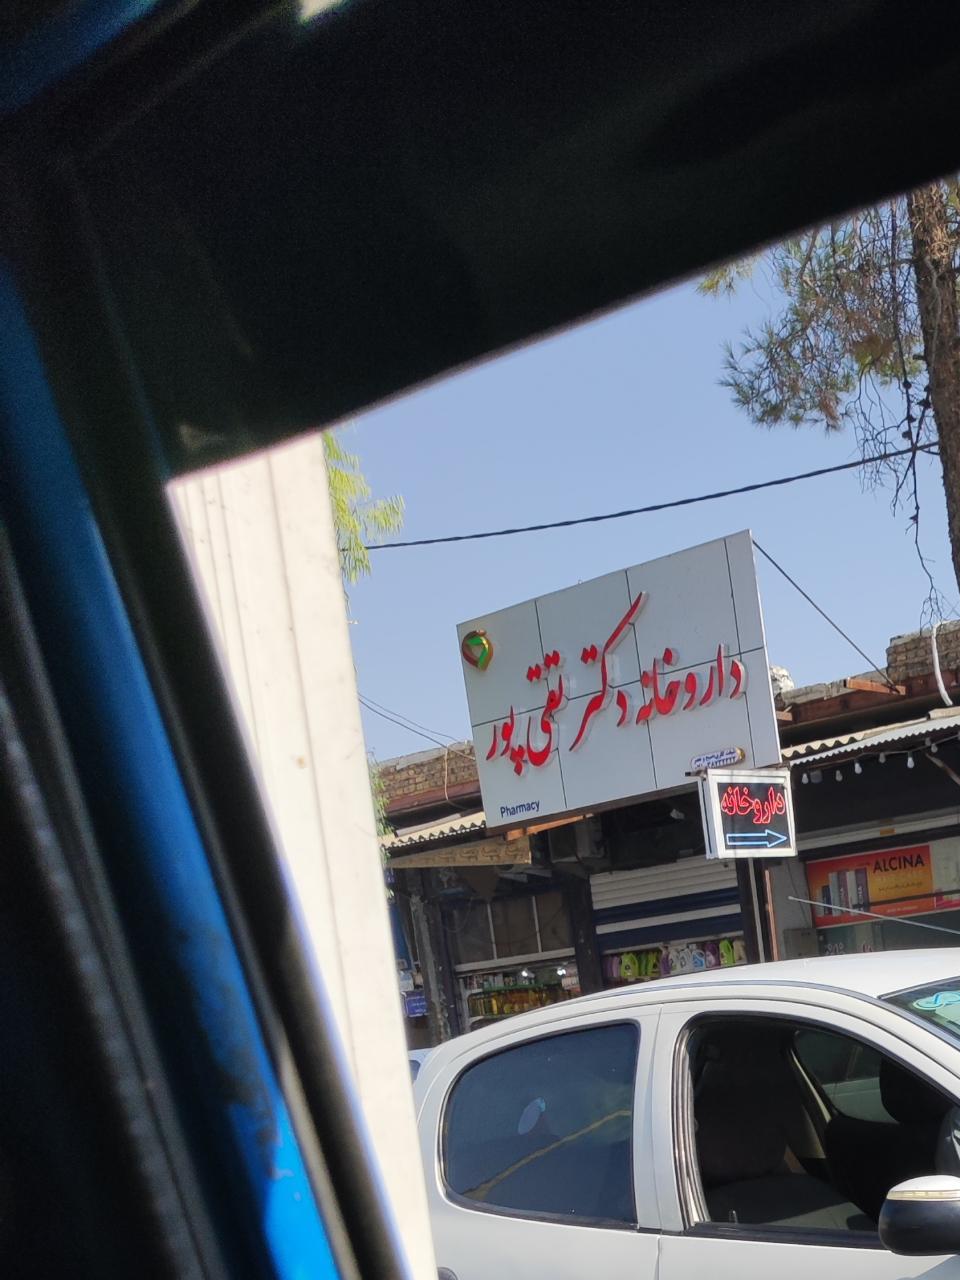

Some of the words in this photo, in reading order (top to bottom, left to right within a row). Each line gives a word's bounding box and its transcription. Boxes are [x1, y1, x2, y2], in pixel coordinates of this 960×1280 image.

[569, 591, 646, 752] دکتر
[636, 643, 745, 726] داروخانه
[486, 705, 526, 776] پور
[526, 650, 565, 768] تقی
[499, 799, 541, 819] Pharmacy
[720, 786, 786, 824] داروخانه
[872, 853, 925, 874] ALCINA
